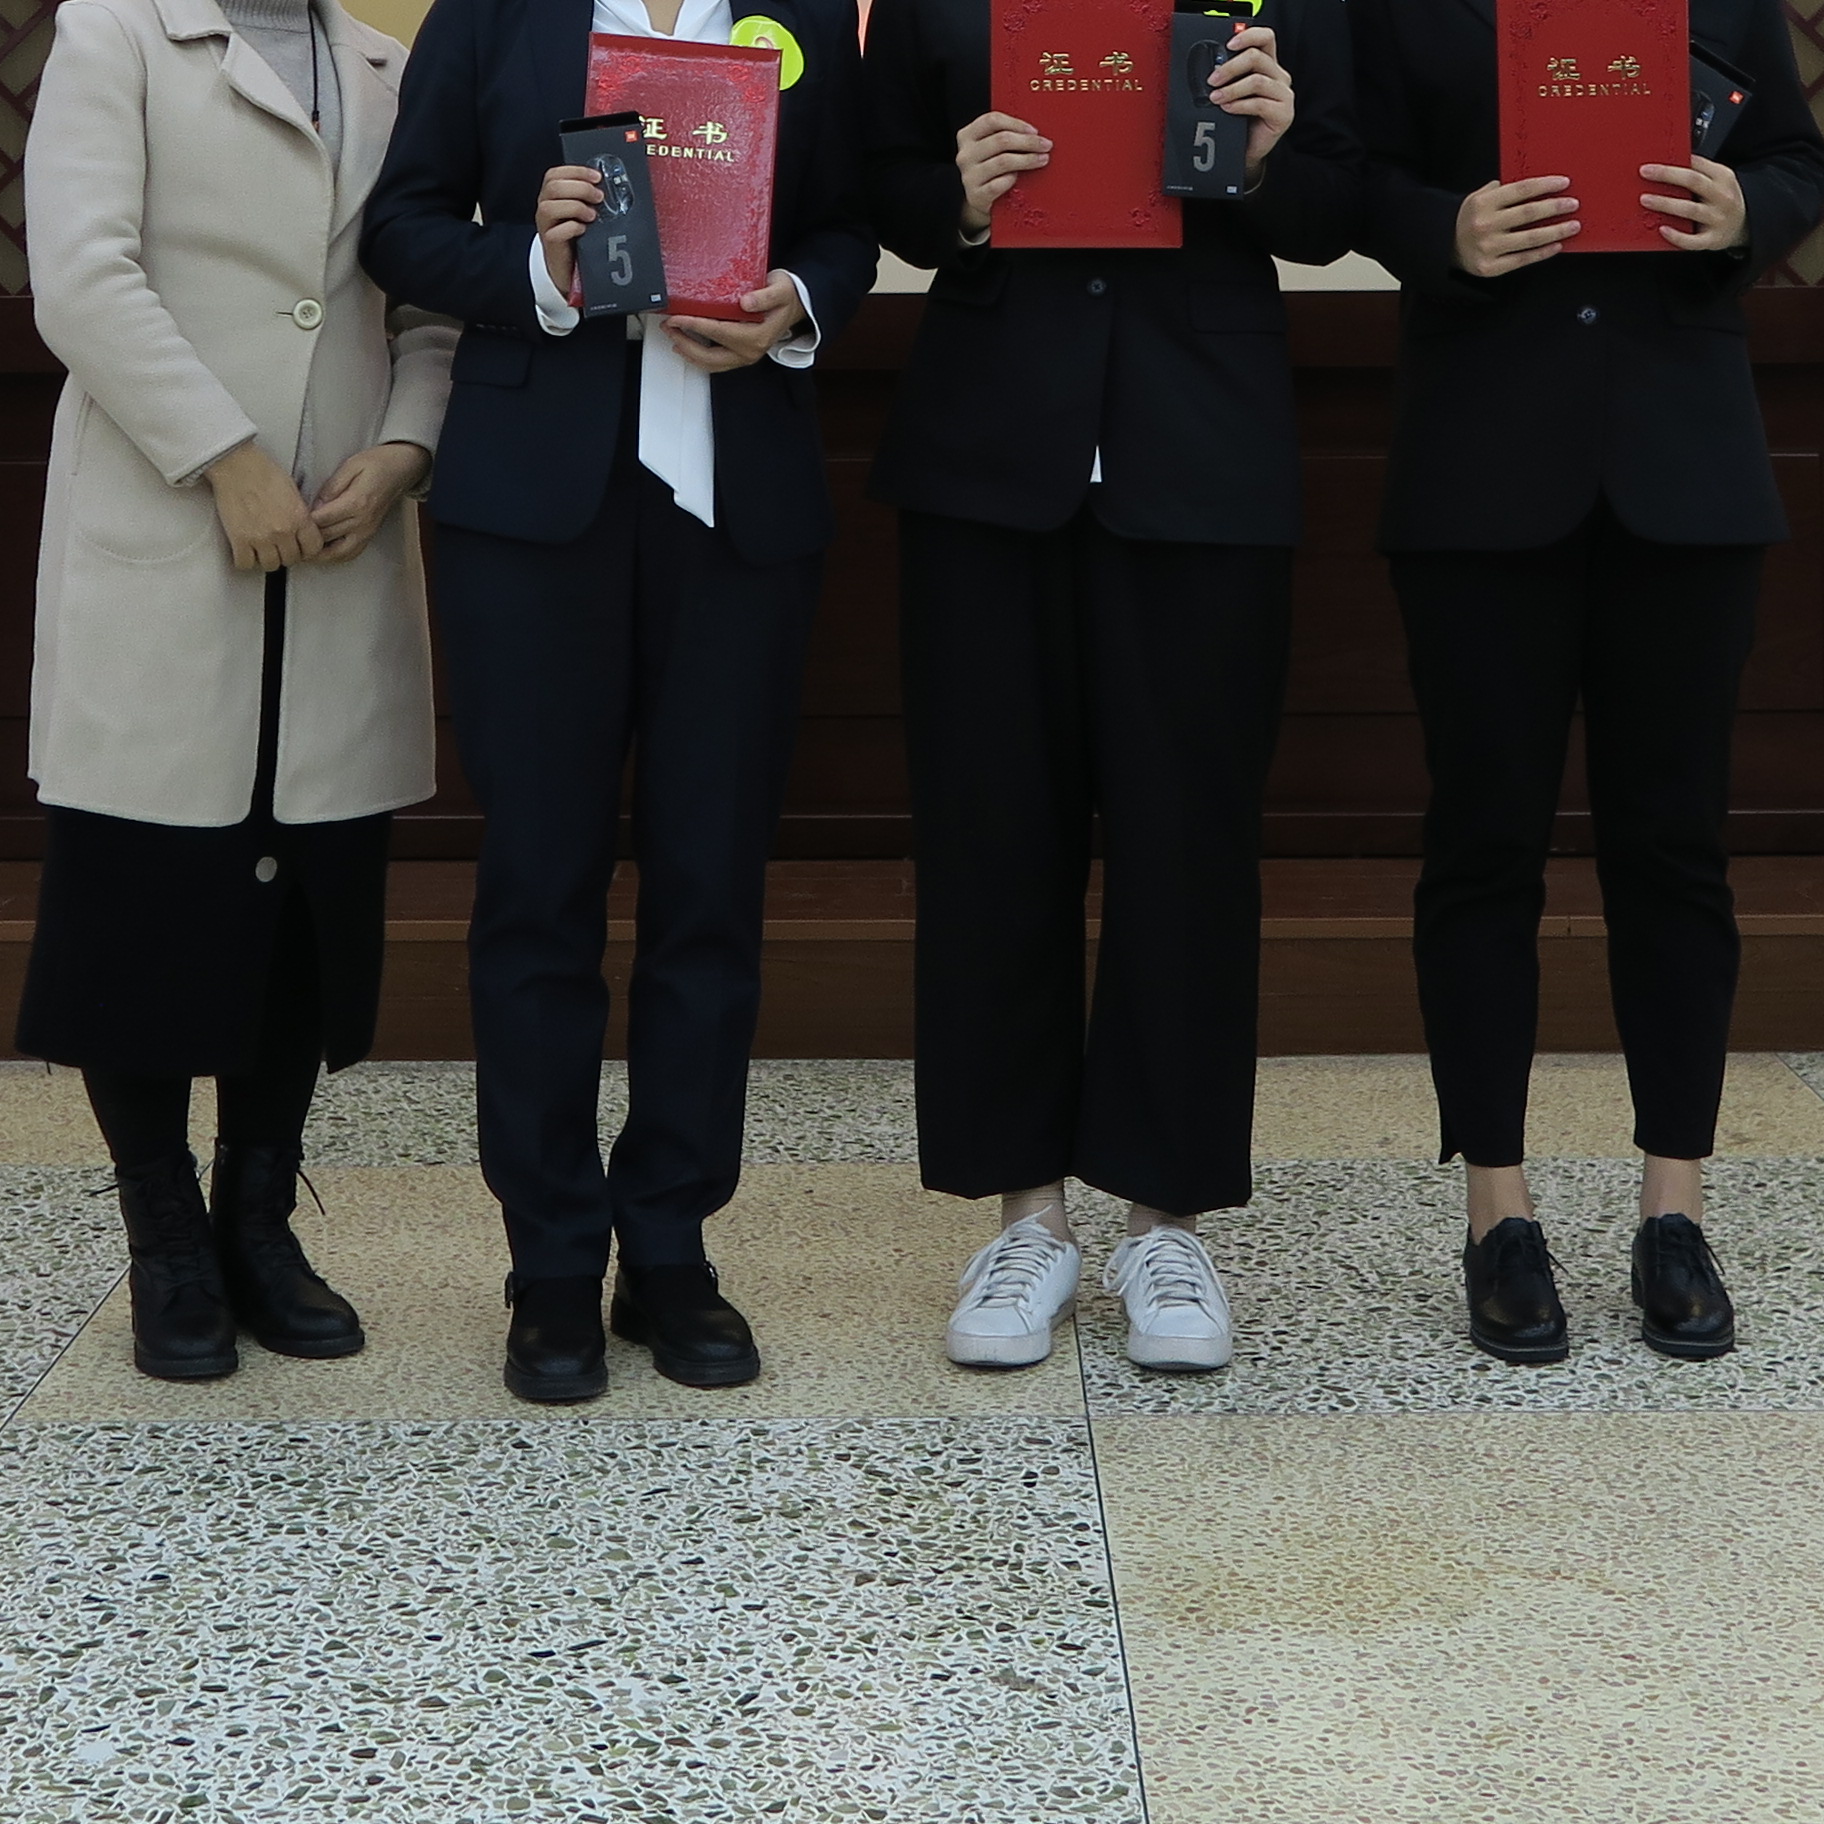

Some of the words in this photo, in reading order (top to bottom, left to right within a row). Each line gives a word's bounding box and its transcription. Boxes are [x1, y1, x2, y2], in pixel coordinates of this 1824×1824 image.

[1039, 51, 1134, 76] 证书
[1546, 55, 1641, 81] 证书
[1030, 79, 1143, 92] CREDENTIAL
[1538, 83, 1651, 98] CREDENTIAL
[646, 143, 735, 163] EDENTIAL
[1192, 121, 1216, 173] 5
[607, 234, 633, 286] 5
